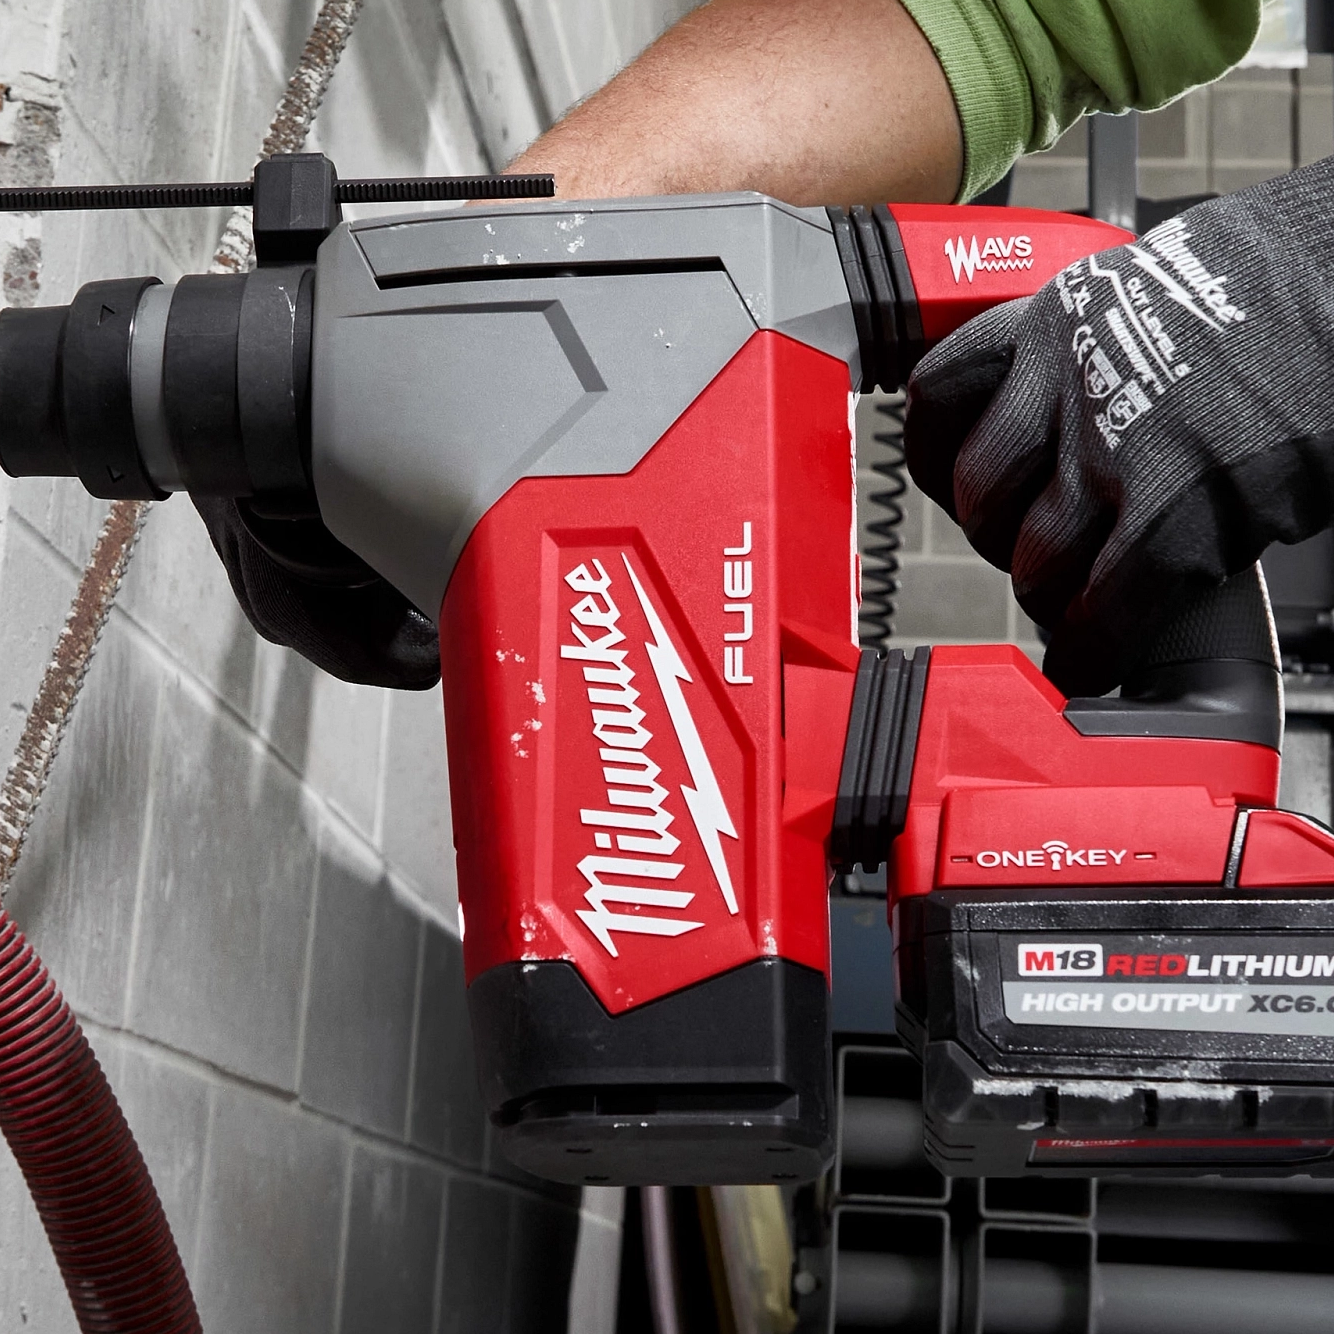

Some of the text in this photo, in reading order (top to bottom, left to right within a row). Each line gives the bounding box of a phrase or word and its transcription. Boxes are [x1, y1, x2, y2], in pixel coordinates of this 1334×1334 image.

[1072, 285, 1092, 317] XL
[1127, 277, 1192, 378] CUT LEVEL 5
[724, 522, 753, 684] FUEL
[560, 558, 705, 957] Milwaukee
[1025, 950, 1097, 971] M18
[1020, 993, 1104, 1013] HIGH
[1112, 993, 1243, 1013] OUTPUT
